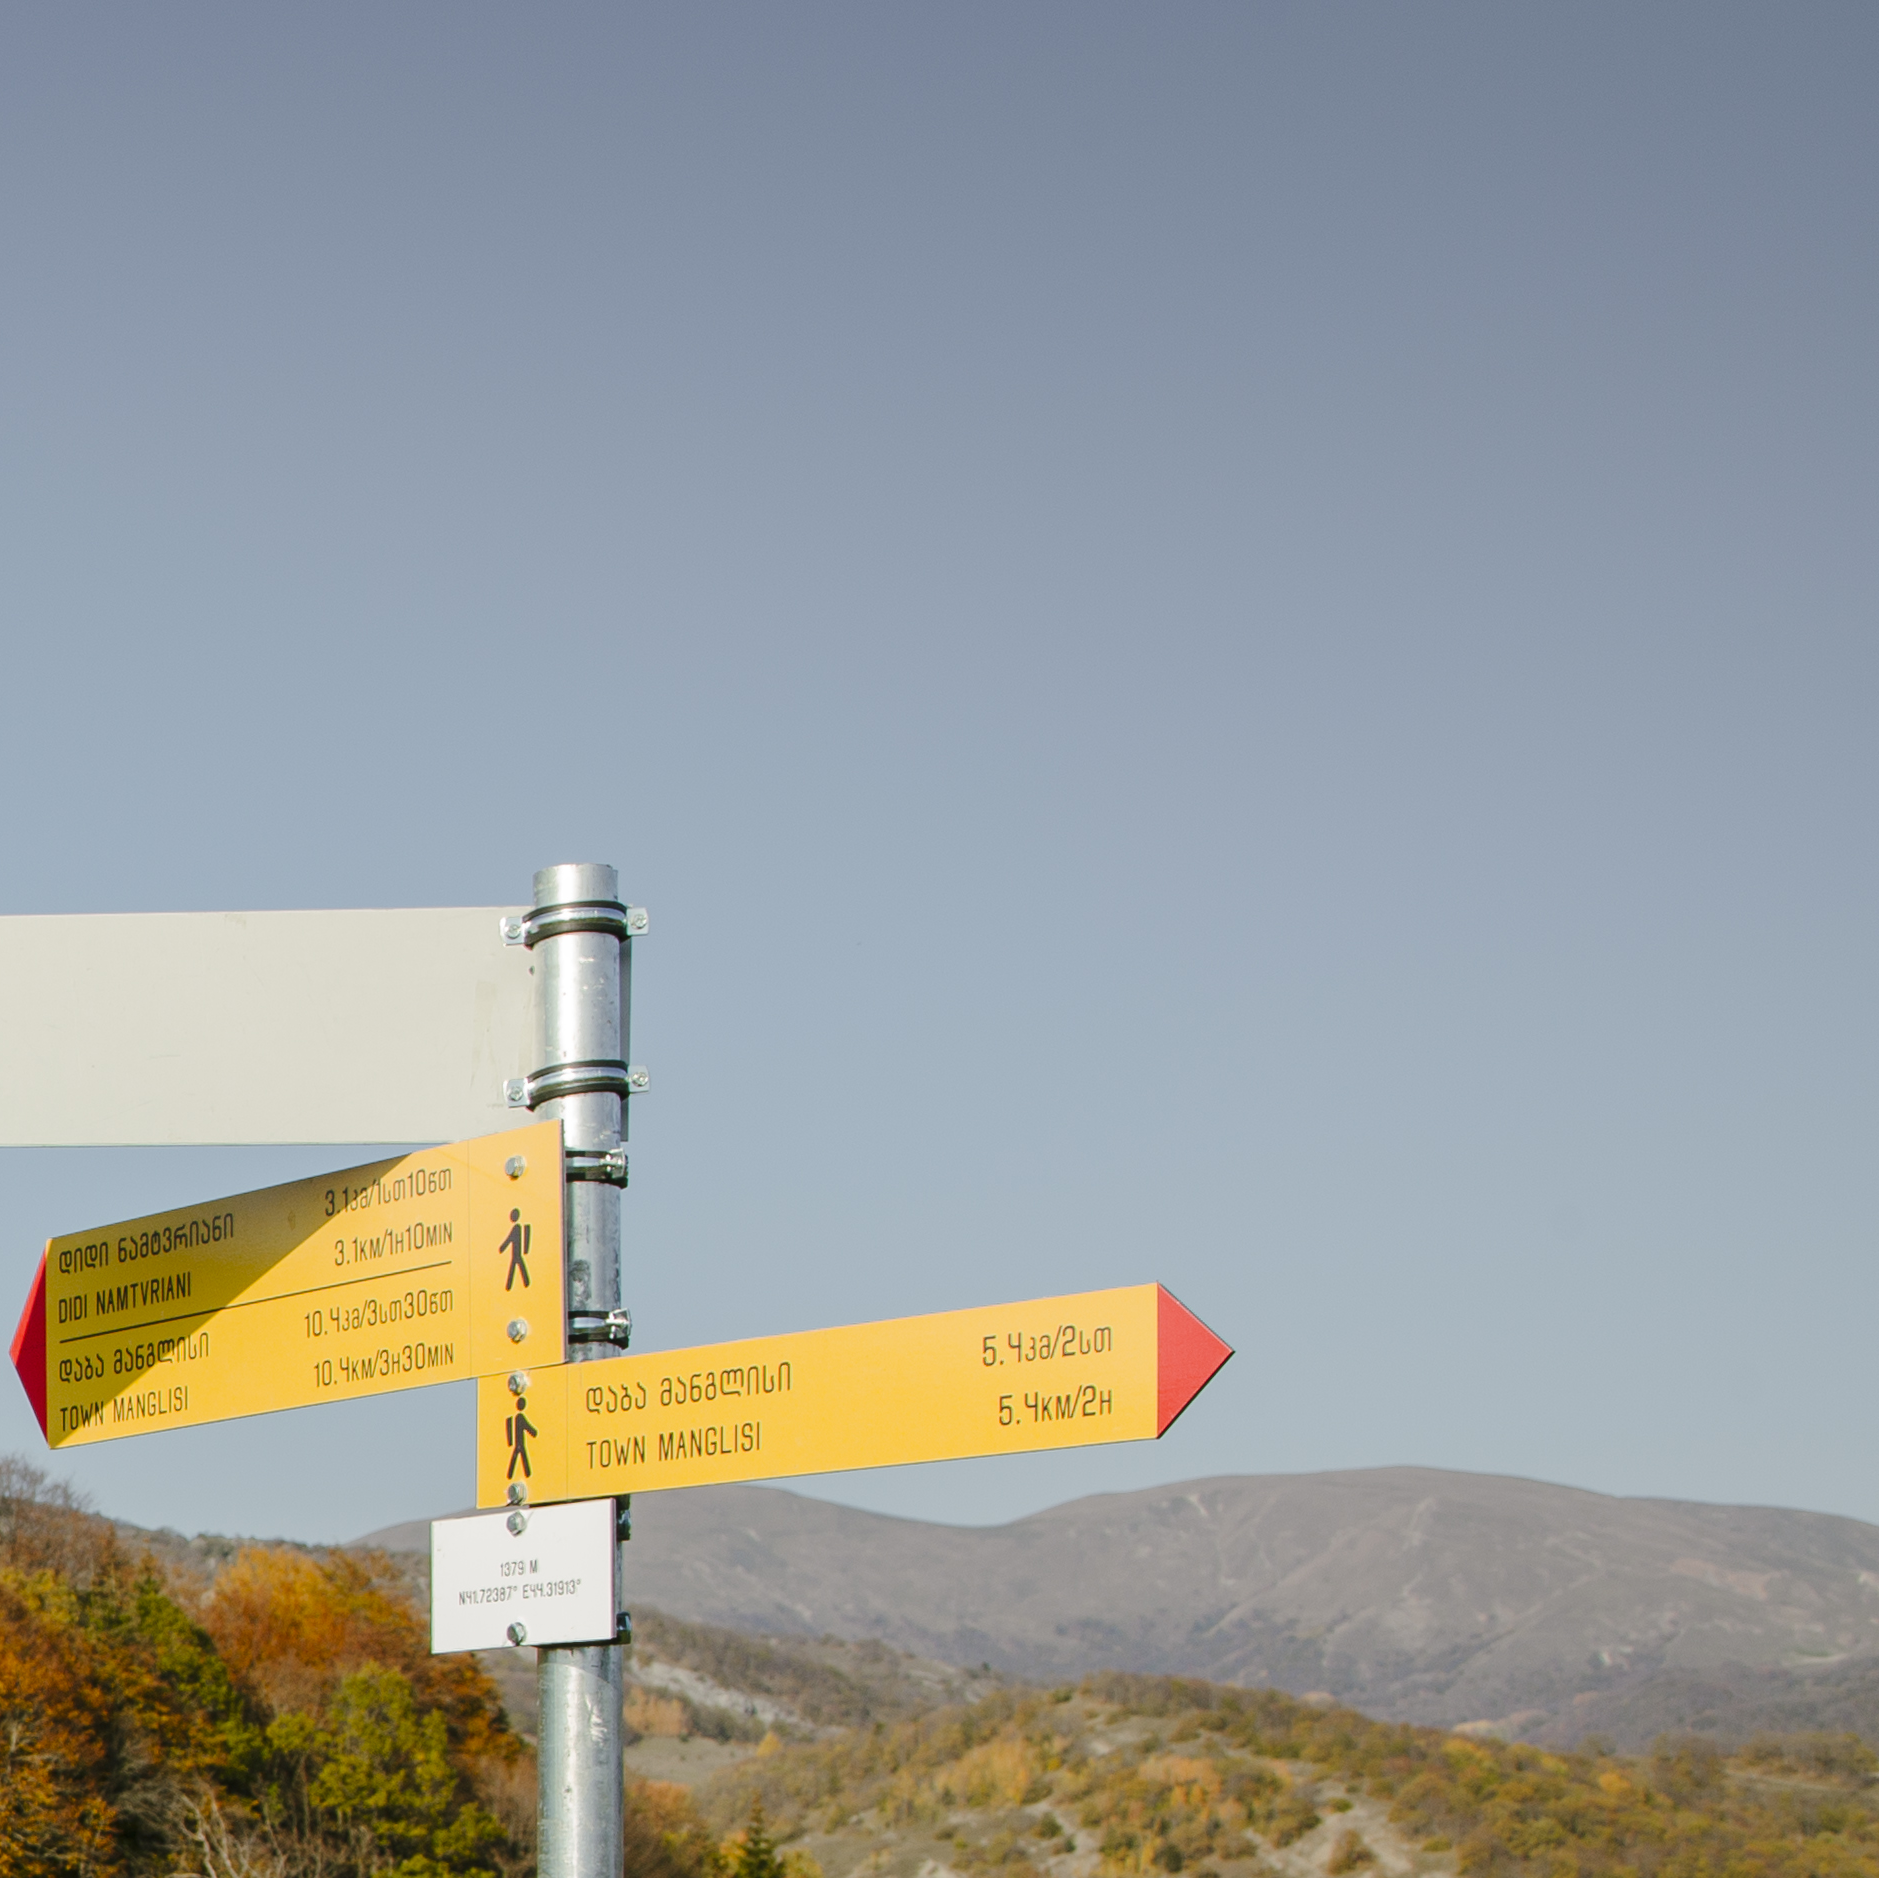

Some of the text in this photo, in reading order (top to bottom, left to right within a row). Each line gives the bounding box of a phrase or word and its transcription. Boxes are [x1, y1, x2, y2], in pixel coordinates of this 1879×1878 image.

[59, 1212, 235, 1274] დიდი ნამტვრიანი
[58, 1271, 192, 1324] DIDI NAMTVRIANI
[59, 1331, 210, 1384] დაბა მანგლისი
[59, 1385, 189, 1432] TOWN MANGLISI
[586, 1361, 792, 1415] დაბა მანგლისი
[586, 1421, 761, 1469] TOWN MANGLISI
[499, 1560, 525, 1577] 1379
